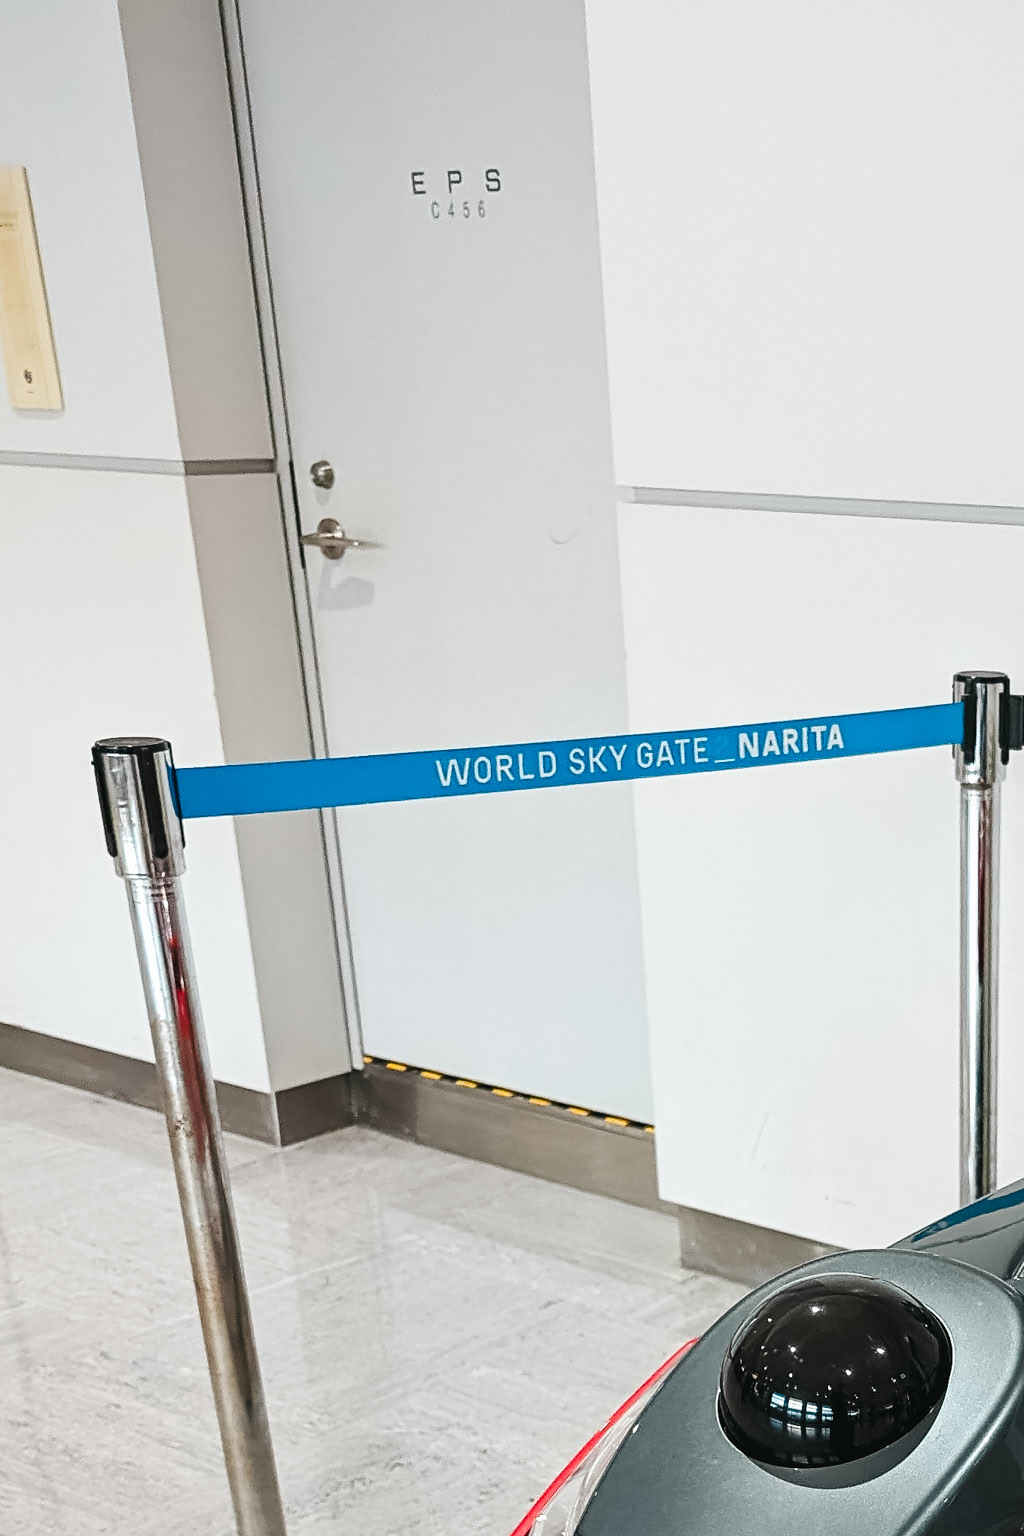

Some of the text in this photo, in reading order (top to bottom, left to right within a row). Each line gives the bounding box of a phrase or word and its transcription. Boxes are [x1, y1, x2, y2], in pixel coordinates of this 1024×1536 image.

[431, 199, 486, 219] C456
[435, 750, 557, 787] WORLD
[568, 743, 628, 775] SKY
